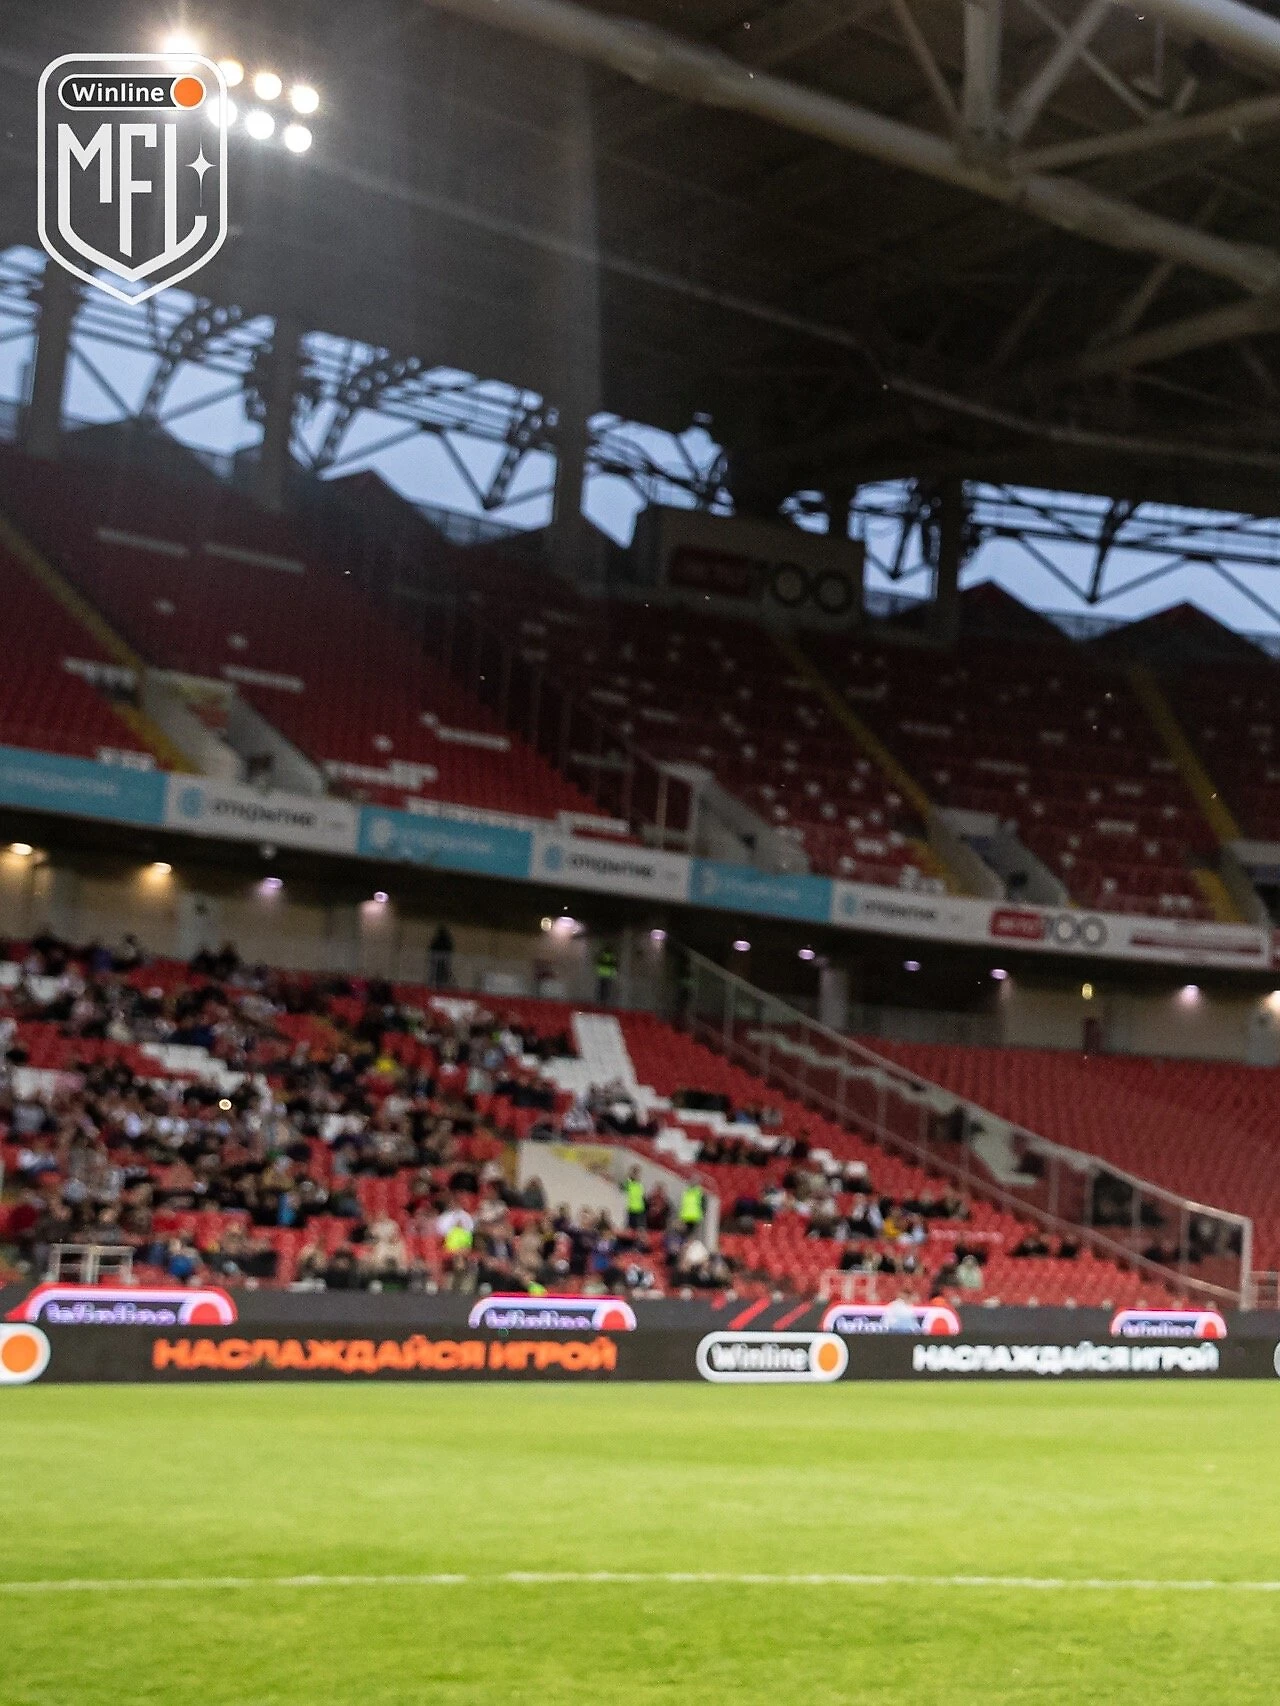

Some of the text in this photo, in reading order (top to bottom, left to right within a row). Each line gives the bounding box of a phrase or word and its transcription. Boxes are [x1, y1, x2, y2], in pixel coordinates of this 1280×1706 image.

[152, 1334, 618, 1374] НАСЛАЖДАЙСЯ ИГРОЙ
[711, 1342, 810, 1371] Winline
